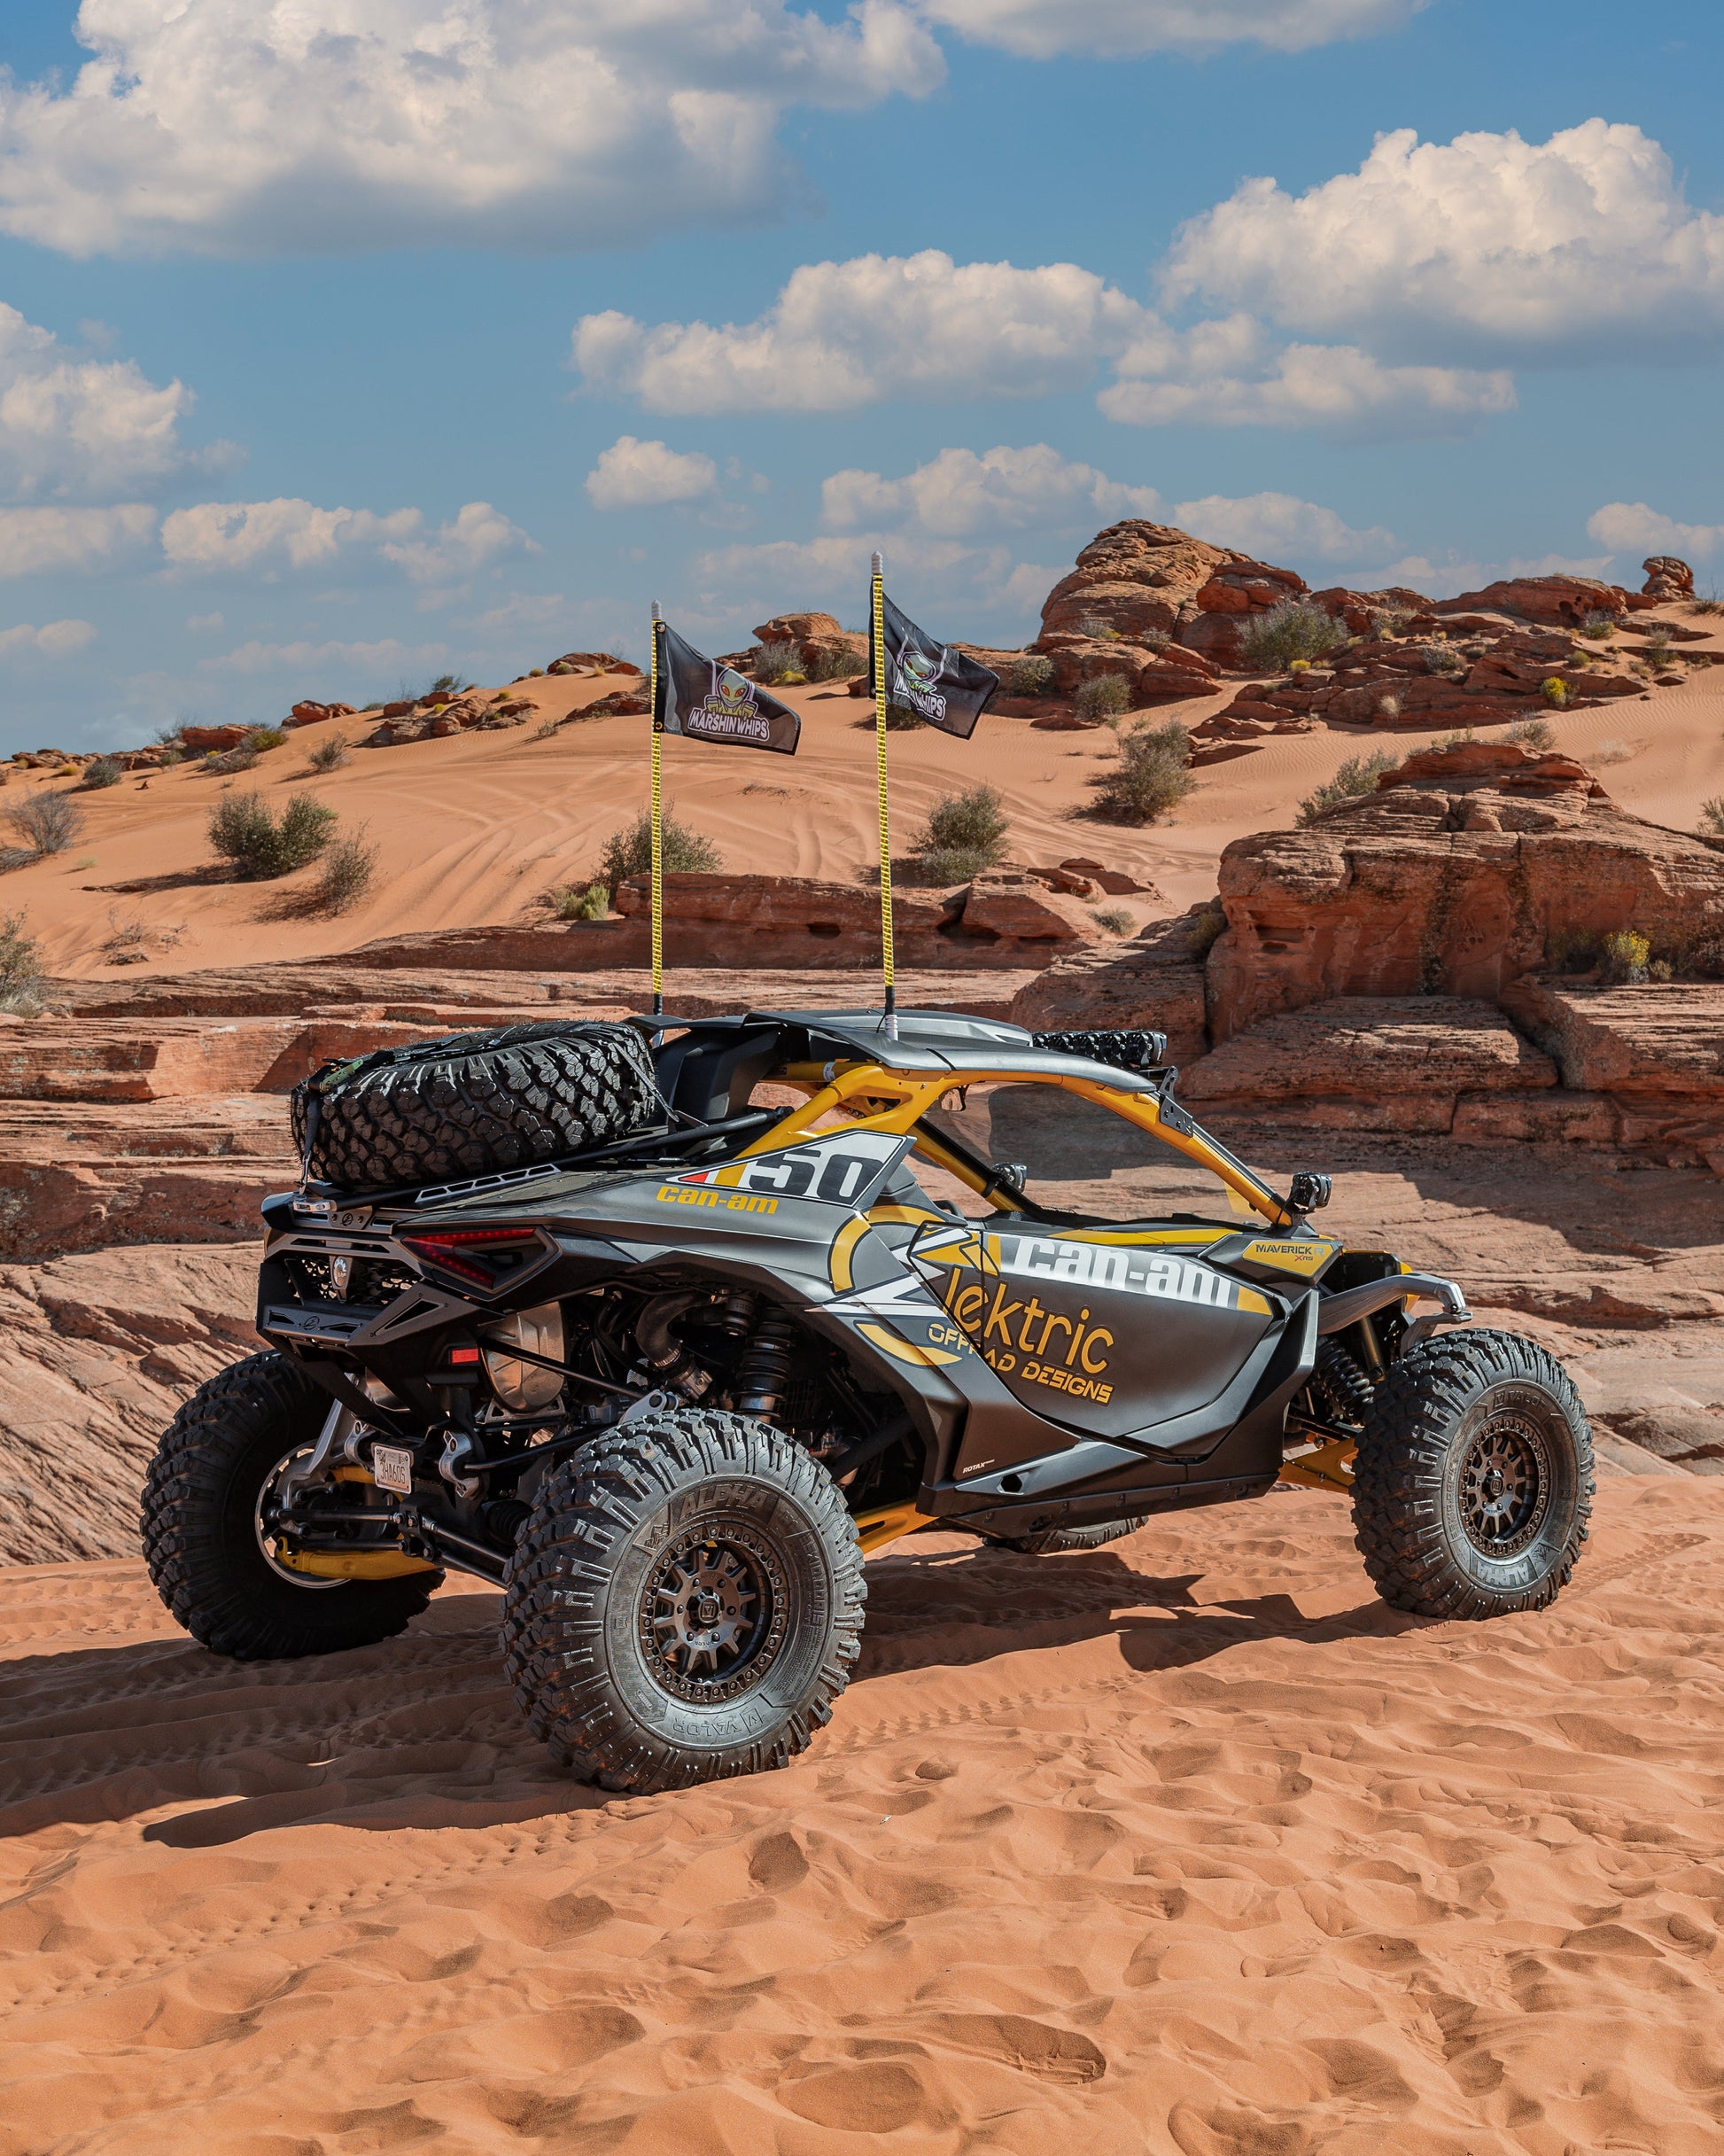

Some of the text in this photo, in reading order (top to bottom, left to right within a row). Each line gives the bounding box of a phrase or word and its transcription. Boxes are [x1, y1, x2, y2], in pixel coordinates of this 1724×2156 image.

[689, 710, 767, 738] MARSHIN WHIPS
[749, 1147, 885, 1206] 50
[656, 1185, 779, 1215] can-am
[1255, 1244, 1312, 1255] MAVERICK
[1013, 1238, 1231, 1308] can-am
[943, 1267, 1114, 1374] lektric
[928, 1323, 1114, 1403] OFFAD DESIGNS
[962, 1462, 984, 1474] ROTAX
[679, 1483, 771, 1522] ALPHA
